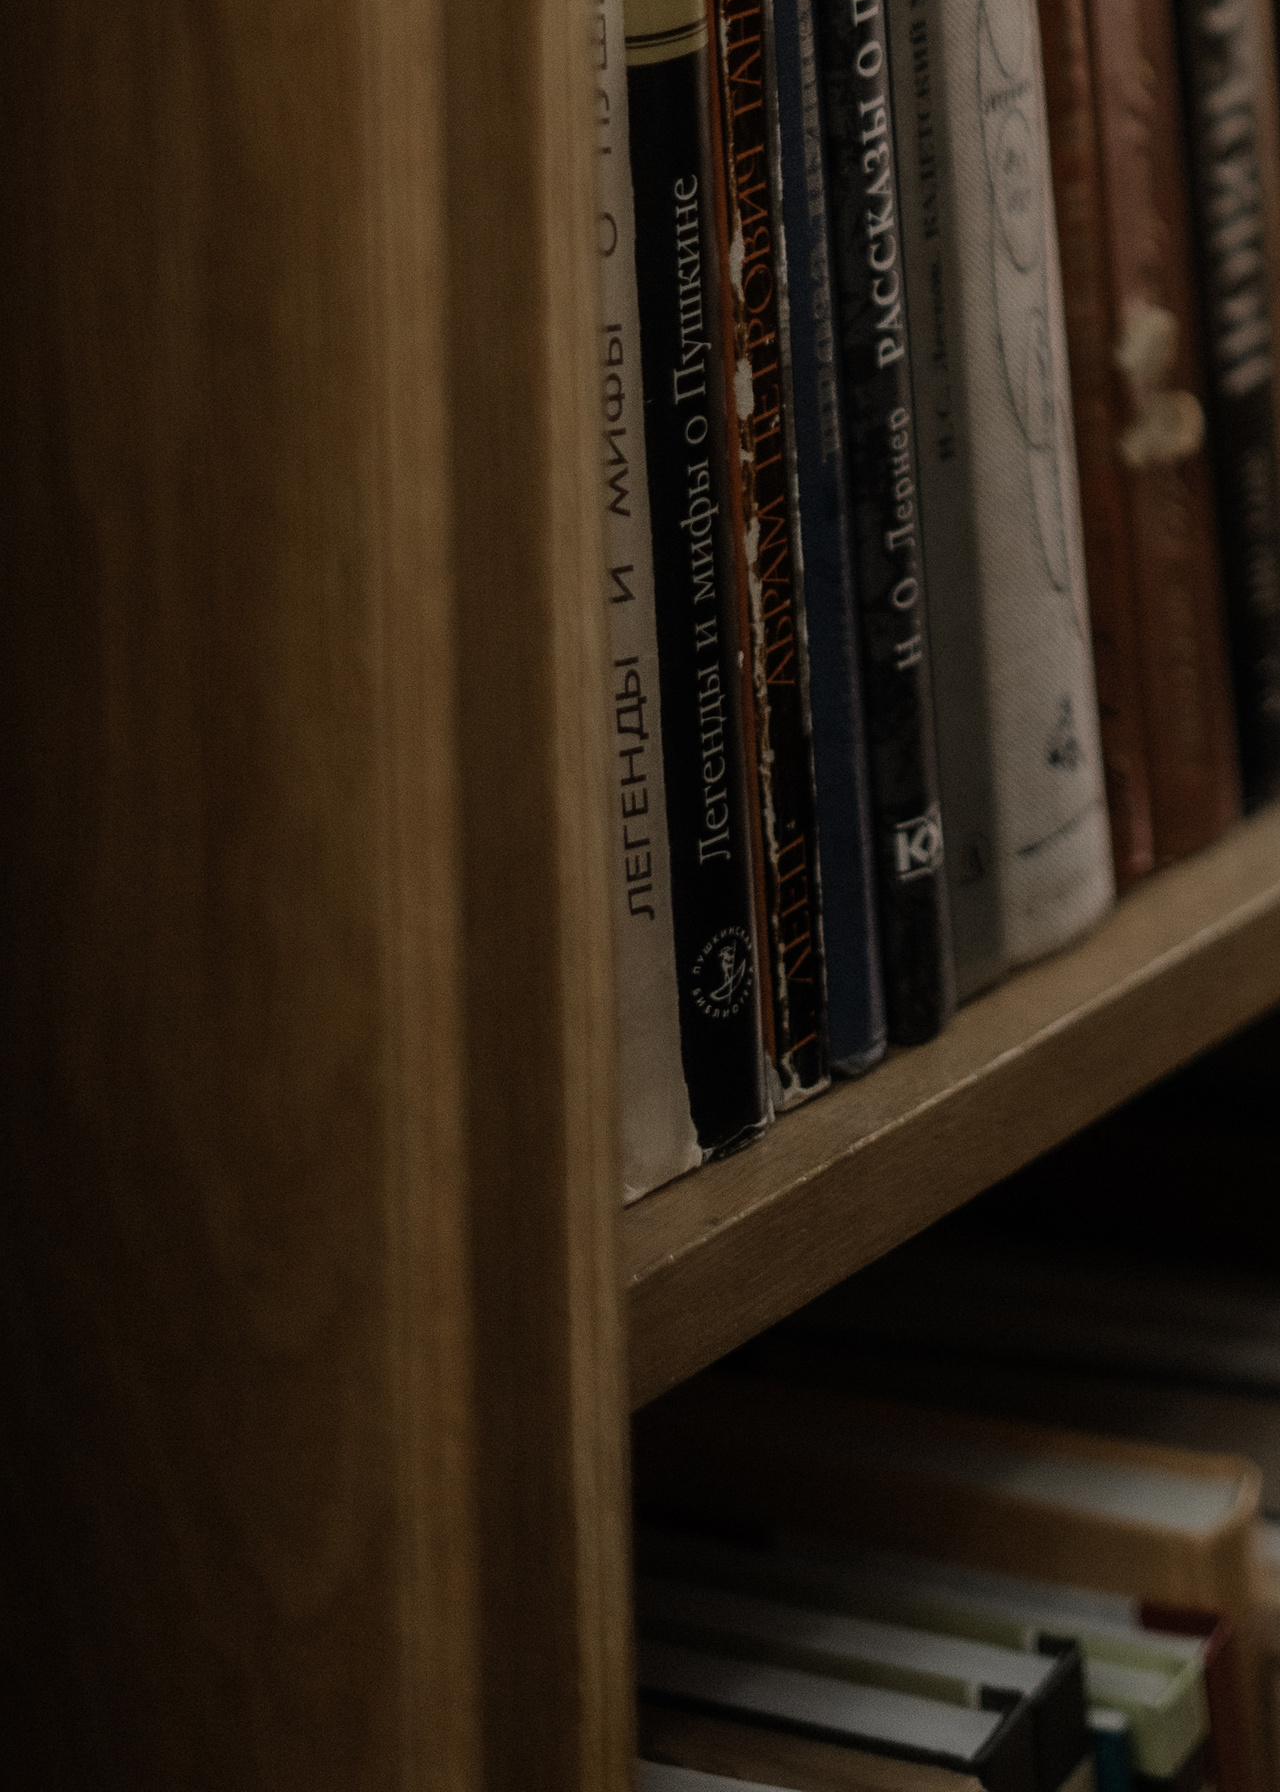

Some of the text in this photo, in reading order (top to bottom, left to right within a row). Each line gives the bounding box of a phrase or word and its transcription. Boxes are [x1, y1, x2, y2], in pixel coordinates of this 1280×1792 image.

[856, 39, 883, 79] О
[735, 143, 784, 472] ПЕТРОВИЧ
[859, 94, 905, 370] РАССКАЗЫ
[603, 322, 632, 518] МИФЫ
[885, 407, 917, 552] Лернер
[608, 564, 637, 605] И
[672, 173, 731, 866] Легенды и мифы о Пушкине
[759, 494, 797, 687] АБРАМ
[614, 655, 655, 921] ЛЕГЕНДЫ
